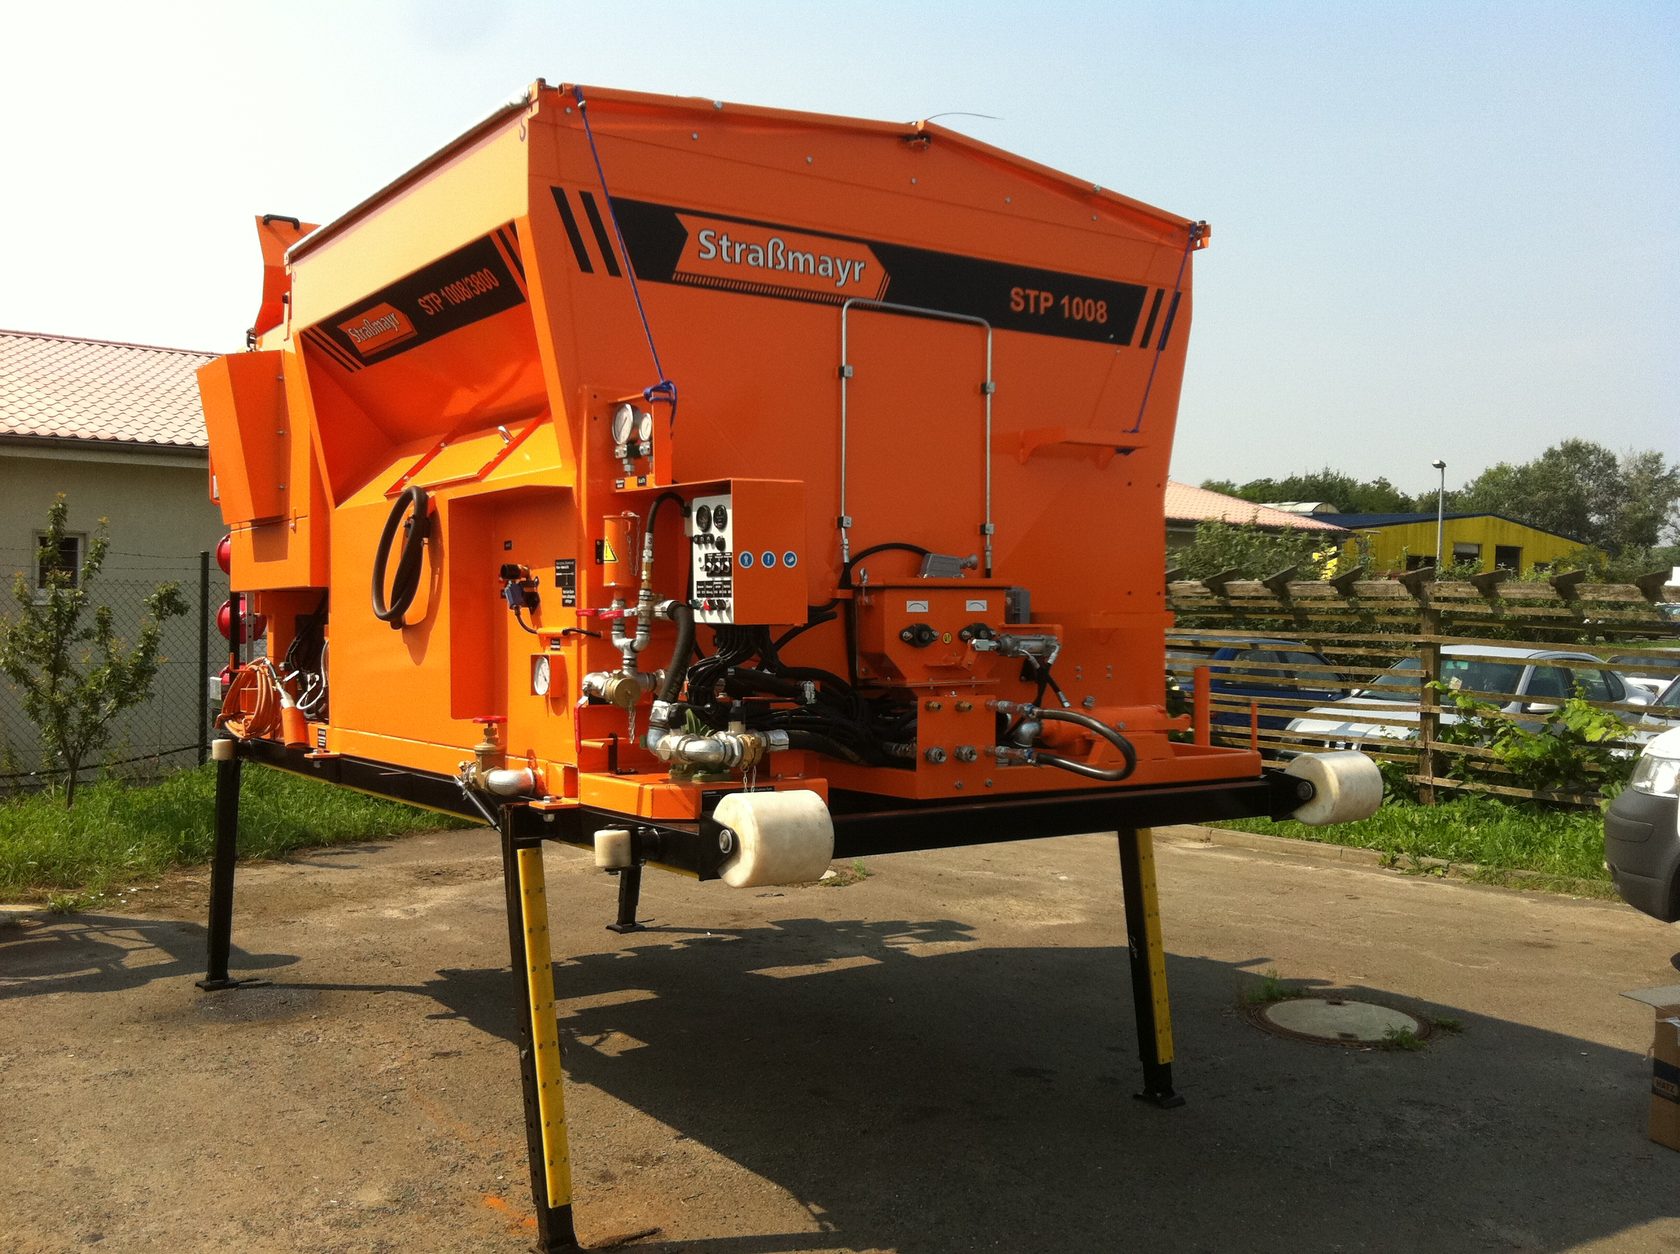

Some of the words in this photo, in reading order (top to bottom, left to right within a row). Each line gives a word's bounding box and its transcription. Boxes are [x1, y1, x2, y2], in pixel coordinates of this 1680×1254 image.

[698, 229, 866, 288] Straßmayr
[418, 292, 444, 315] STP
[440, 268, 499, 305] 1008/3800
[1010, 287, 1054, 315] STP
[1060, 295, 1107, 324] 1008
[348, 312, 399, 343] Straßmayr
